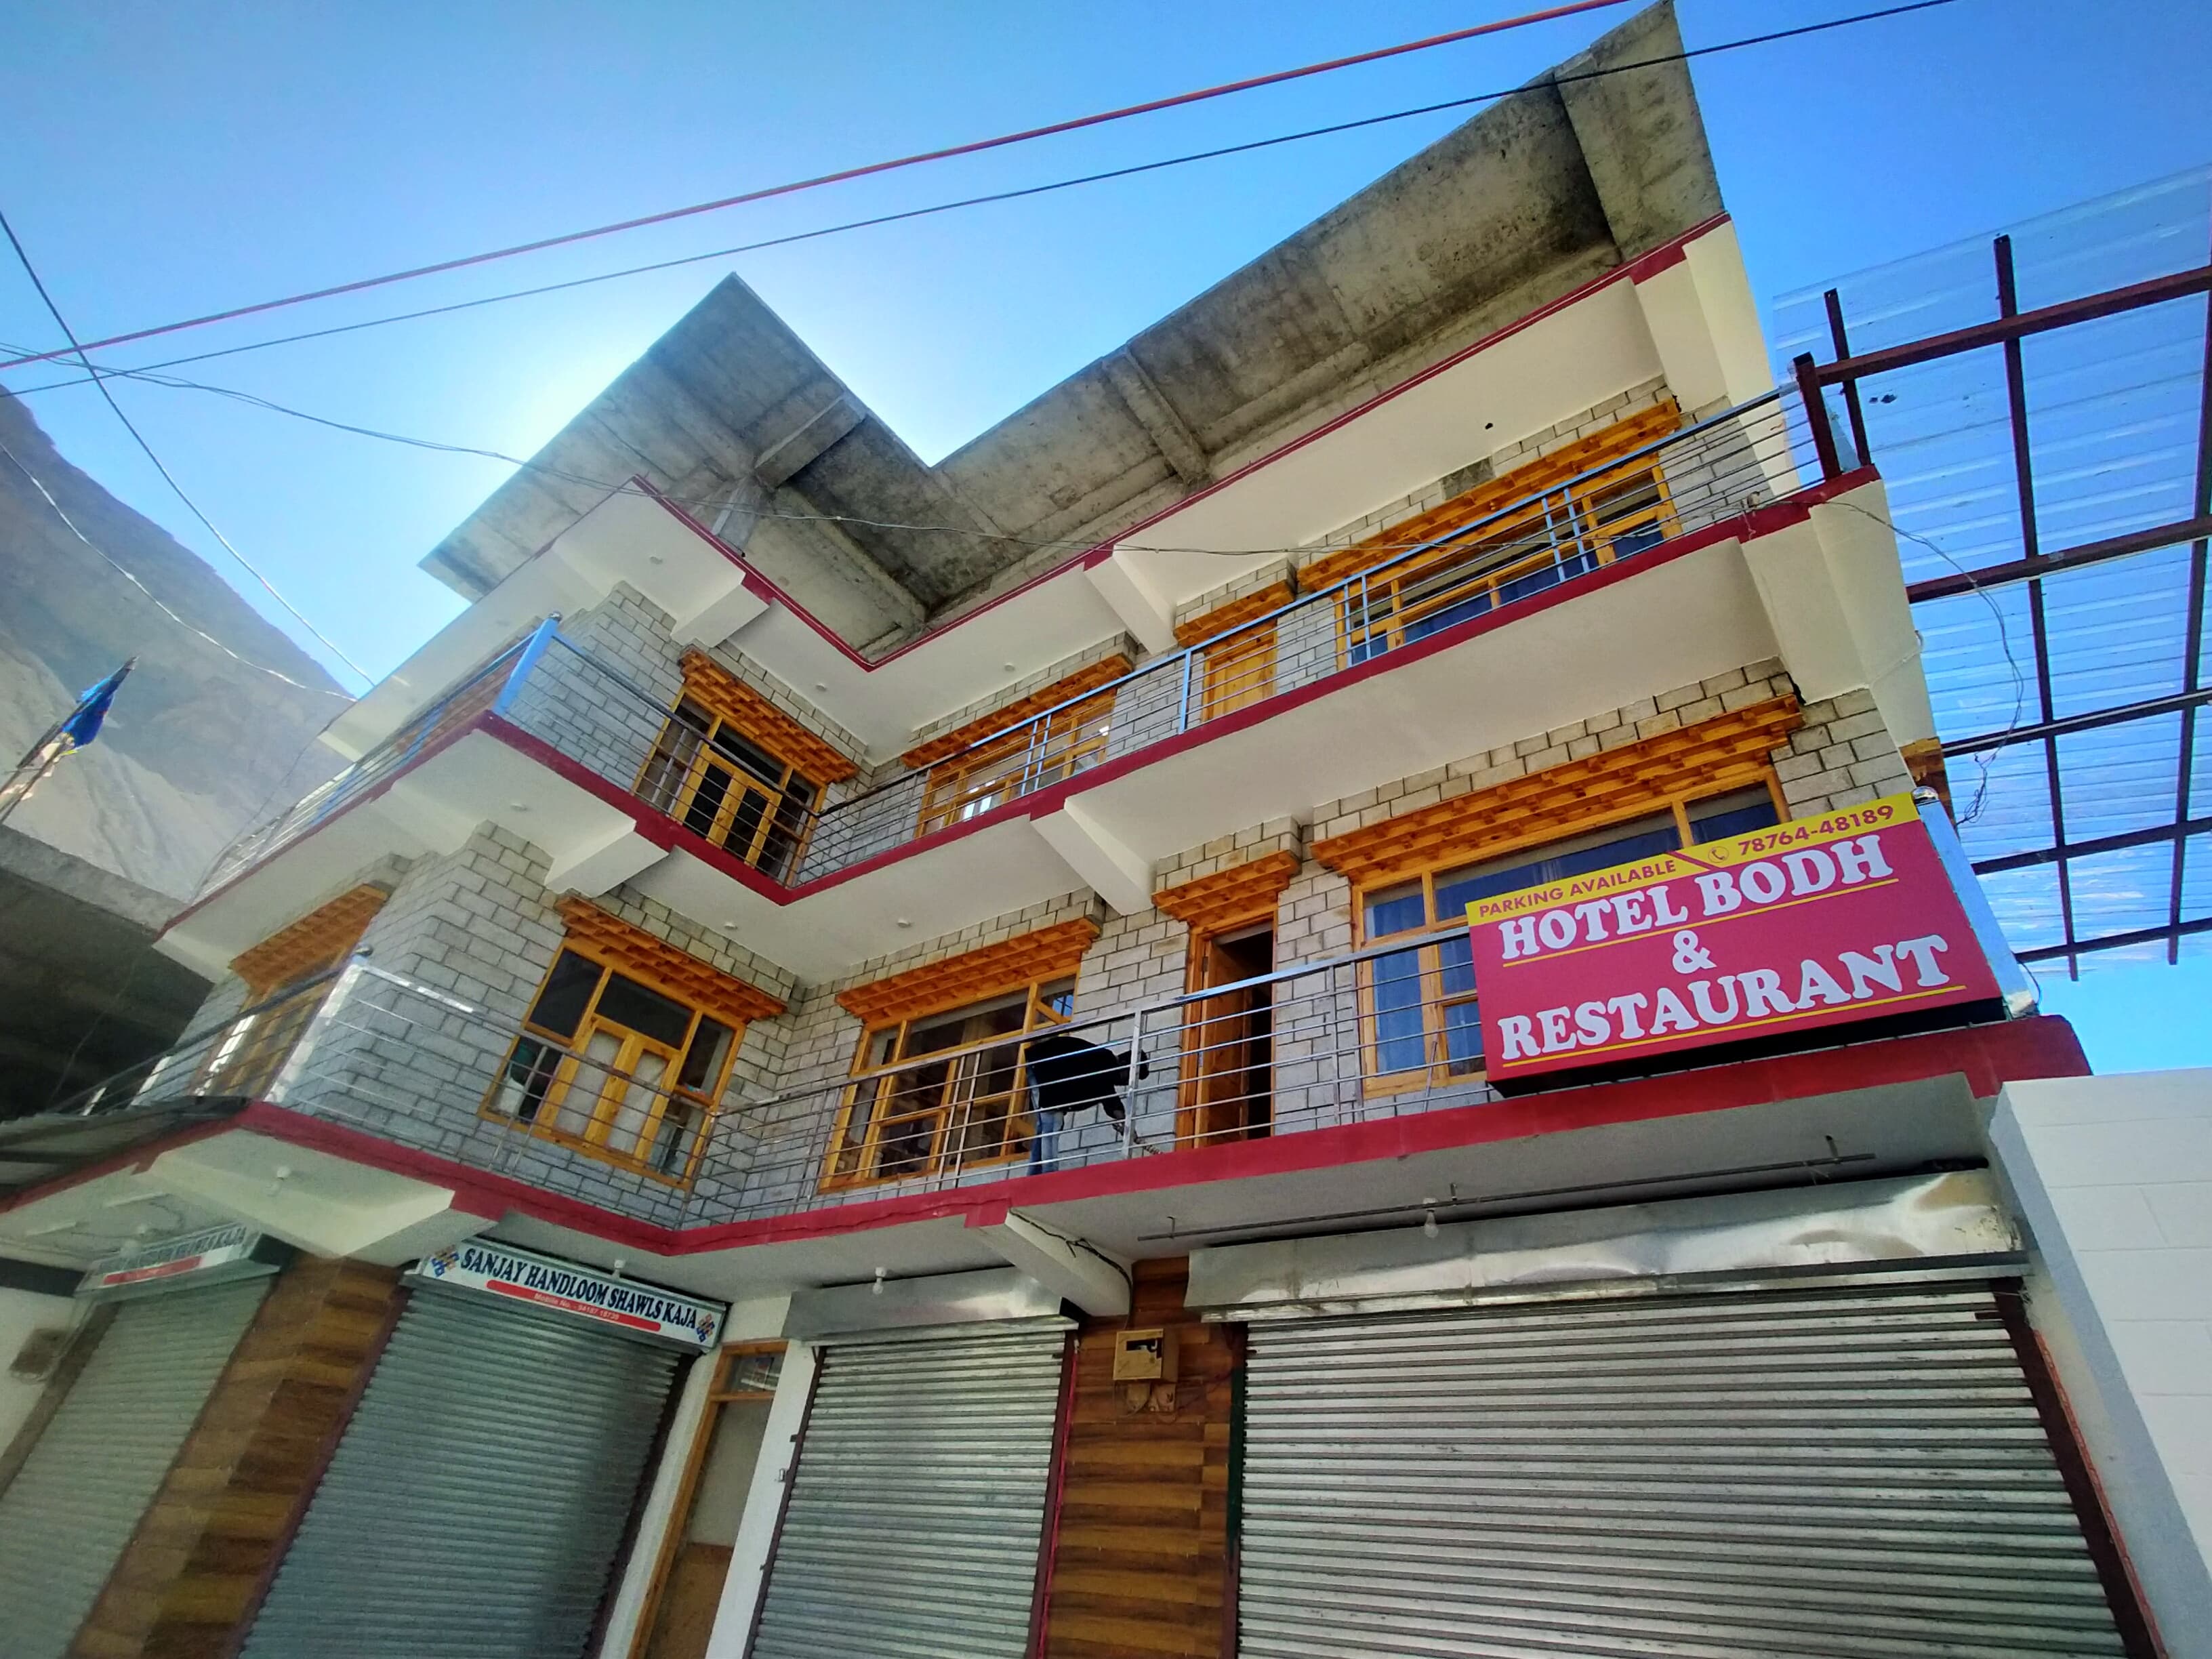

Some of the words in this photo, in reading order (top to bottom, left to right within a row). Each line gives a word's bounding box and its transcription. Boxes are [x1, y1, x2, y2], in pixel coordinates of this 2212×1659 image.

[1738, 804, 1894, 856] 78764-48189
[1479, 887, 1564, 918] PARKING
[1570, 859, 1677, 897] AVAILABLE
[1498, 885, 1689, 960] HOTEL
[1695, 834, 1894, 917] BODH
[1672, 930, 1717, 975] &
[1498, 934, 1949, 1060] RESTAURANT
[460, 1248, 528, 1283] SANJAY
[524, 1265, 610, 1305] HANDLOOM
[607, 1288, 664, 1319] SHAWLS
[662, 1302, 697, 1329] KAJA
